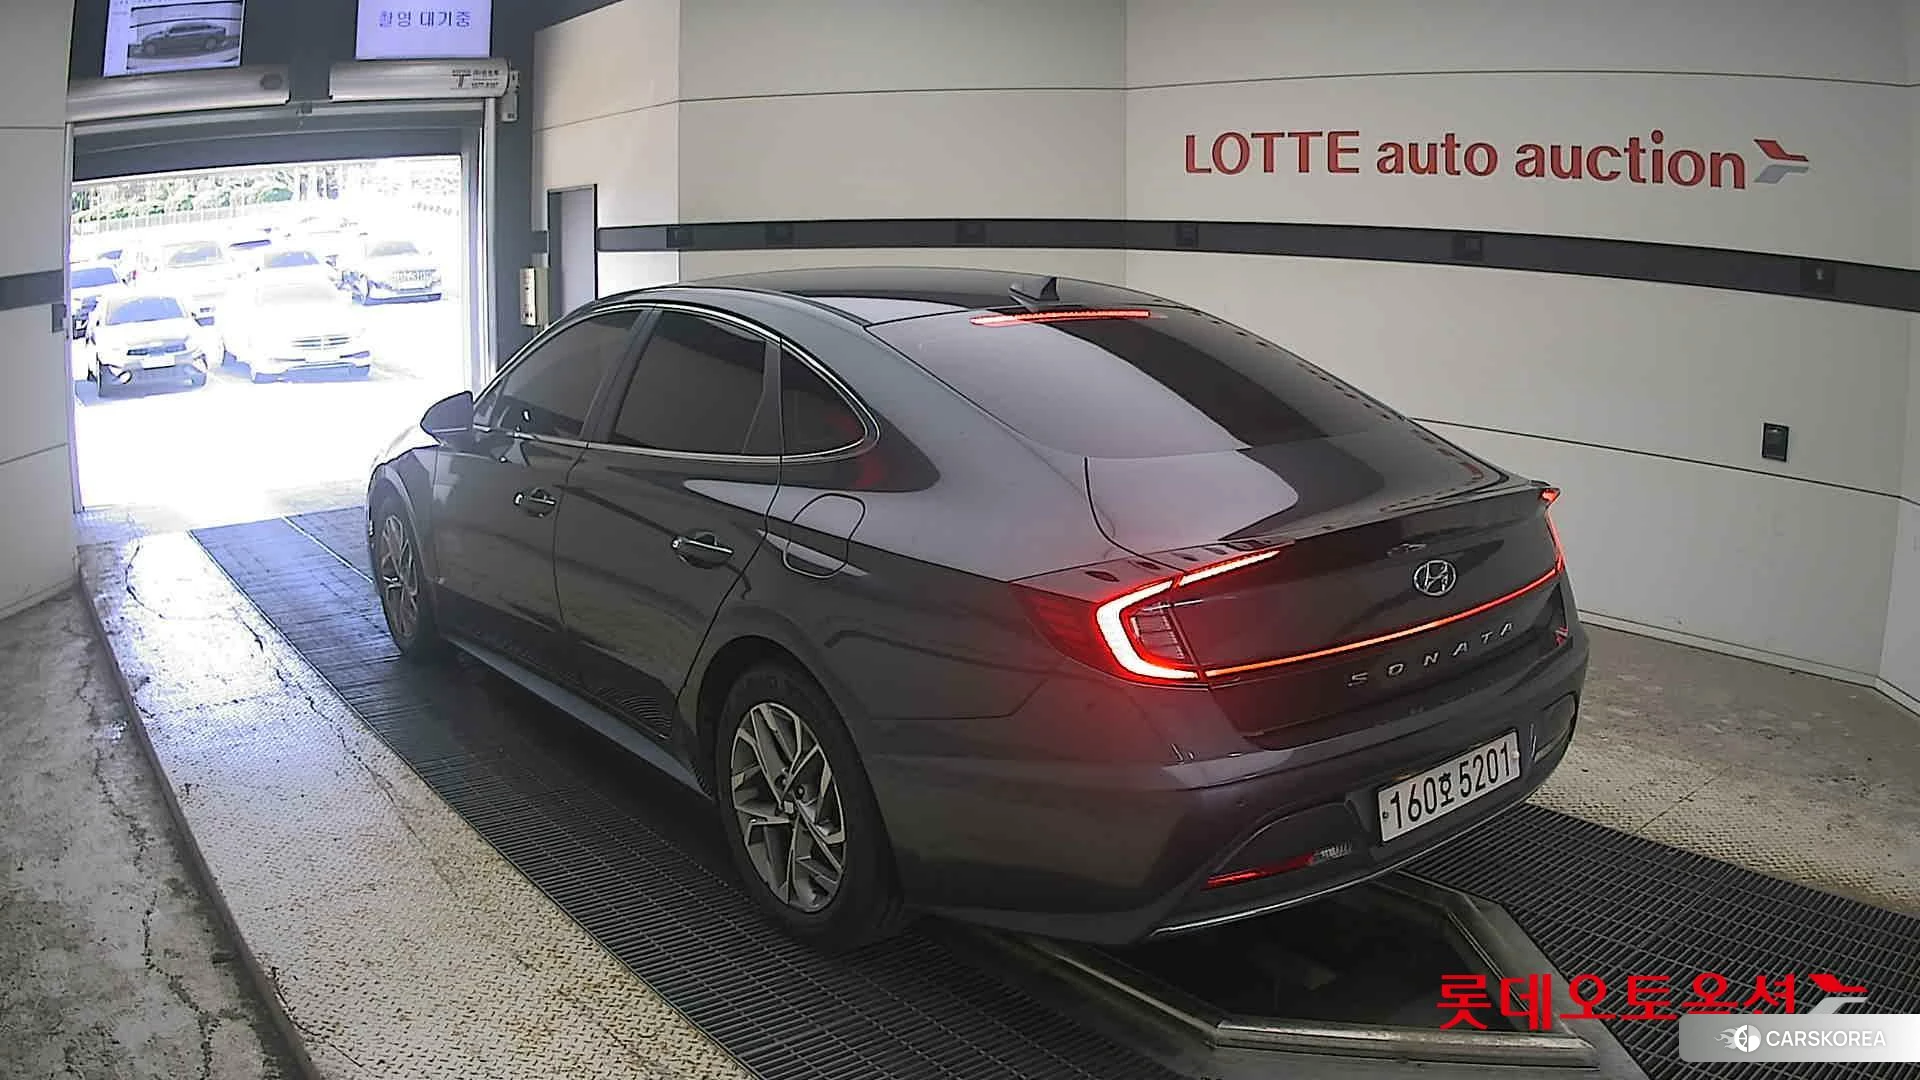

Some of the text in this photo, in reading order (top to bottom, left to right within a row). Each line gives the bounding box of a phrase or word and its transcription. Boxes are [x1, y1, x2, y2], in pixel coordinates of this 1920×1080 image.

[420, 11, 471, 28] 대기중
[1185, 129, 1746, 189] LOTTE auto auction
[1347, 622, 1514, 687] SONATA
[1458, 741, 1510, 798] 5201
